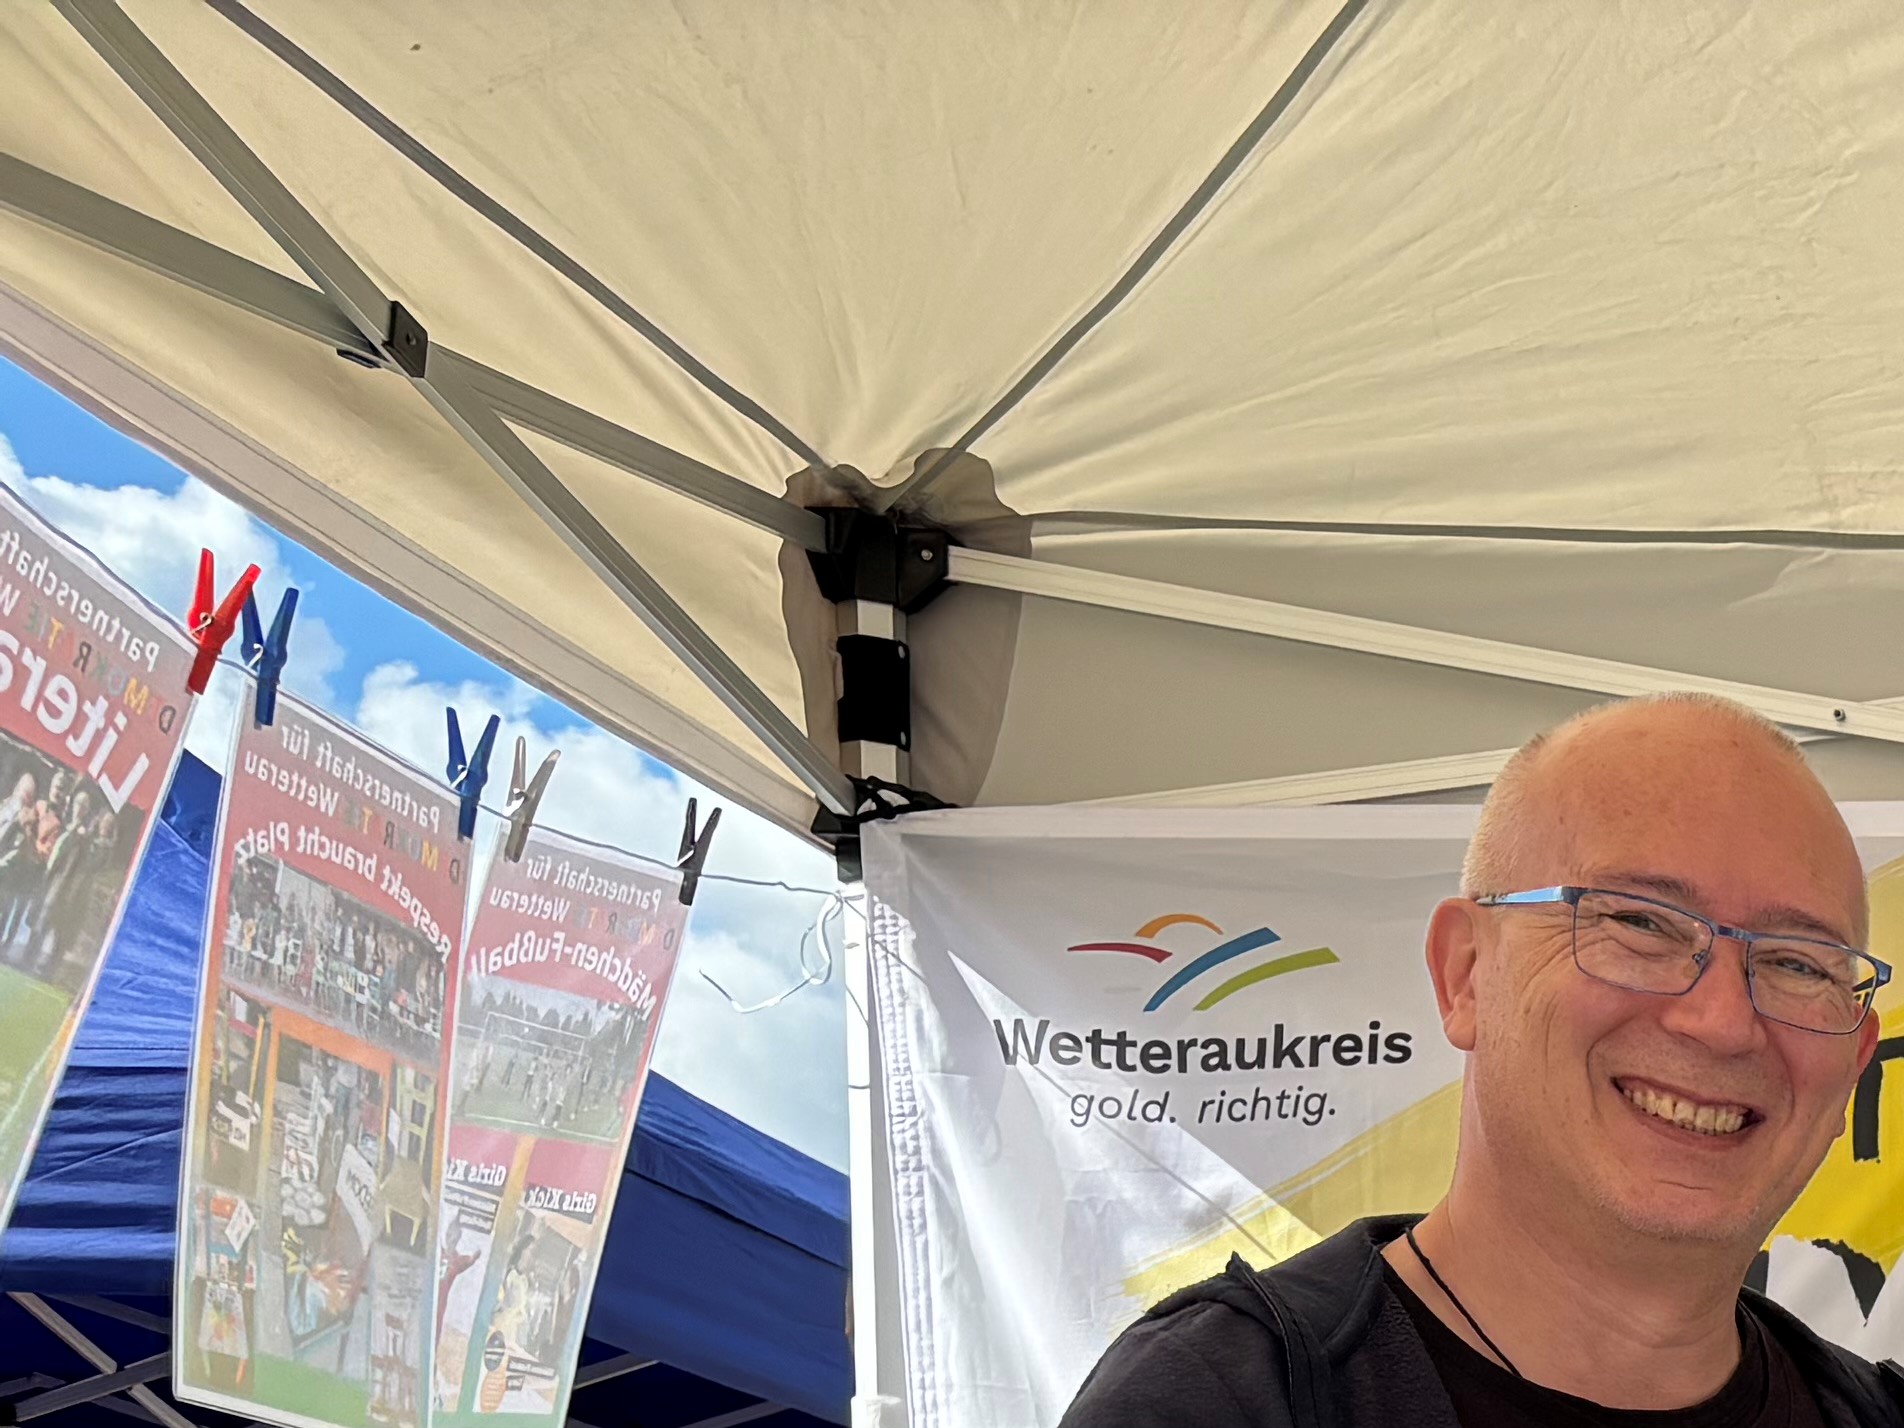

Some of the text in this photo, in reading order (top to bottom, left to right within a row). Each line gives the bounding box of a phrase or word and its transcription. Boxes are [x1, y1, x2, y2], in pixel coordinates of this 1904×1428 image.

[993, 1016, 1414, 1076] Wetteraukreis
[1068, 1085, 1338, 1128] gold. richtig.
